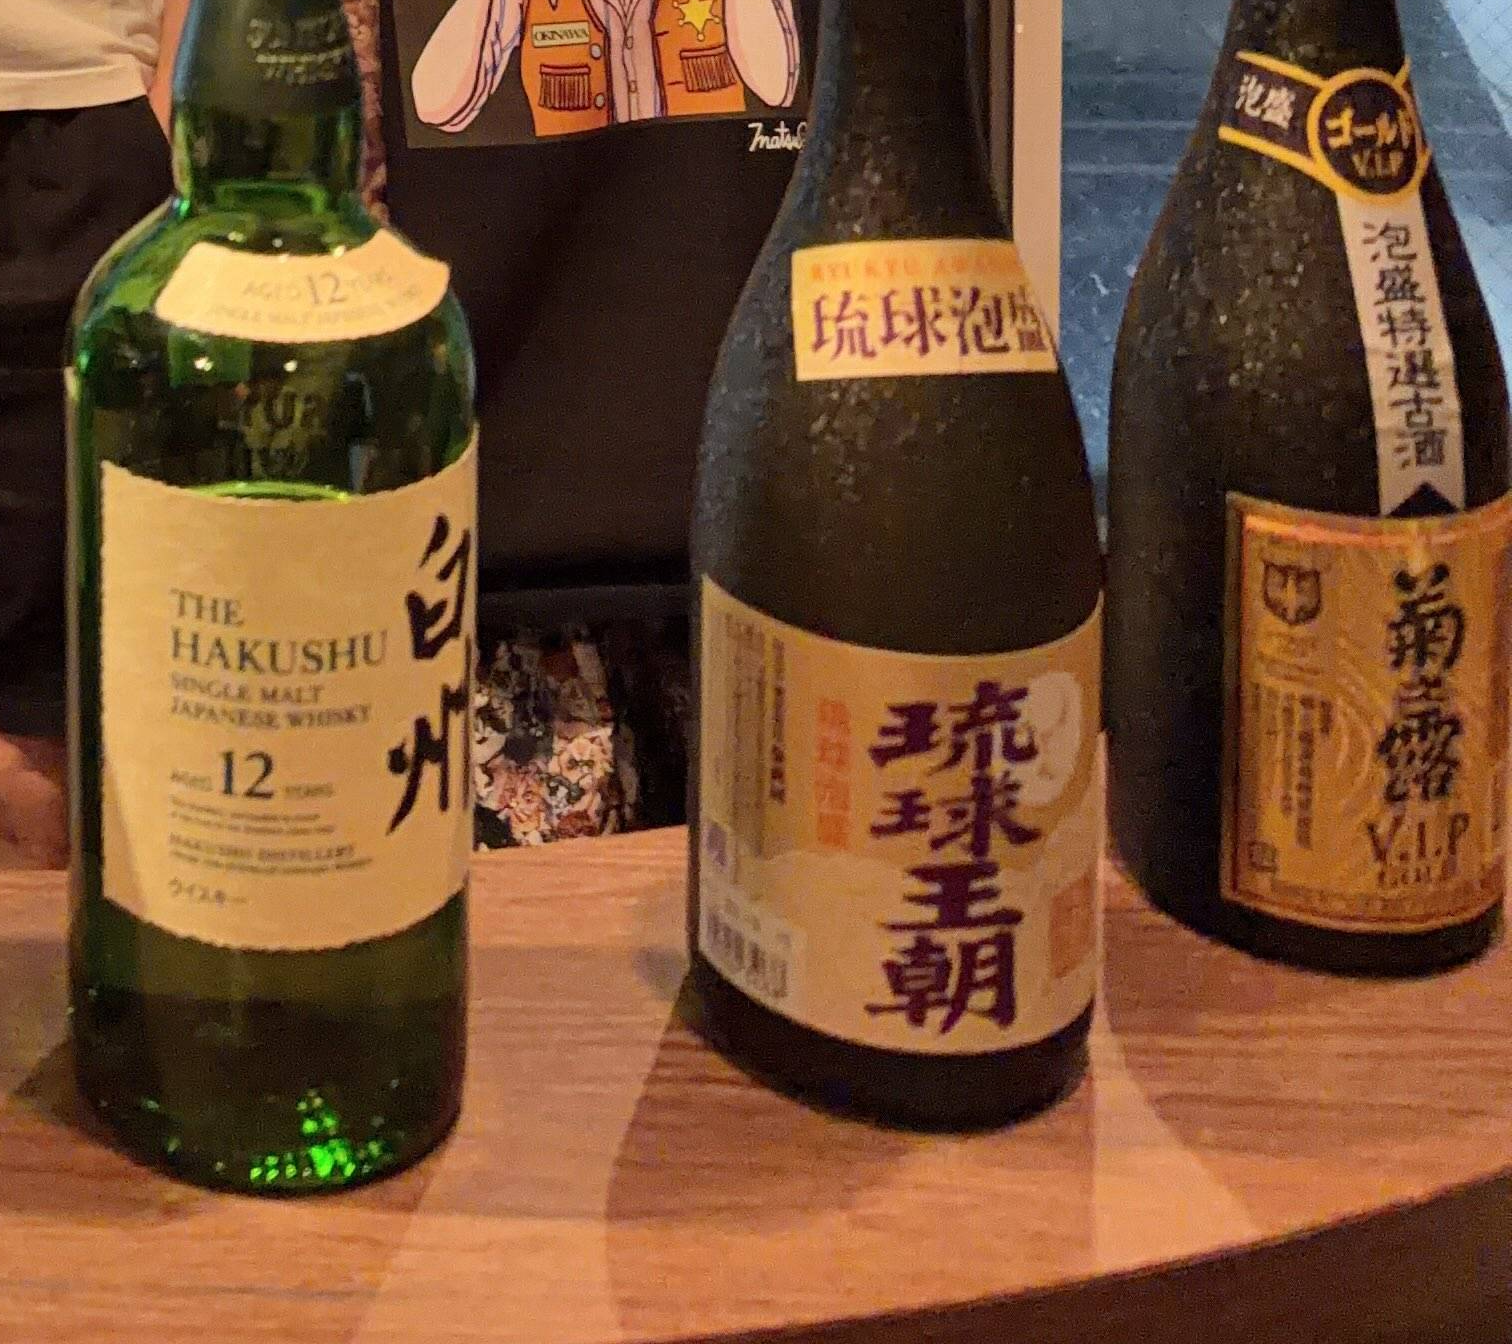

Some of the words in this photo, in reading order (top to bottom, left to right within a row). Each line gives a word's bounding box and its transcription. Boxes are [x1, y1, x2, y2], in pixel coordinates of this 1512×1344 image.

[307, 270, 348, 306] 12
[812, 285, 1048, 362] 琉球泡盛
[1361, 222, 1446, 470] 泡盛特選古酒
[170, 588, 245, 627] THE
[171, 626, 388, 675] HAKUSHU
[386, 513, 472, 838] 白州
[171, 670, 252, 702] SINGLE
[260, 684, 325, 704] MALT
[171, 694, 281, 730] JAPANESE
[285, 702, 372, 729] WHISKY
[220, 749, 275, 800] 12
[864, 679, 1042, 1035] 琉球王朝
